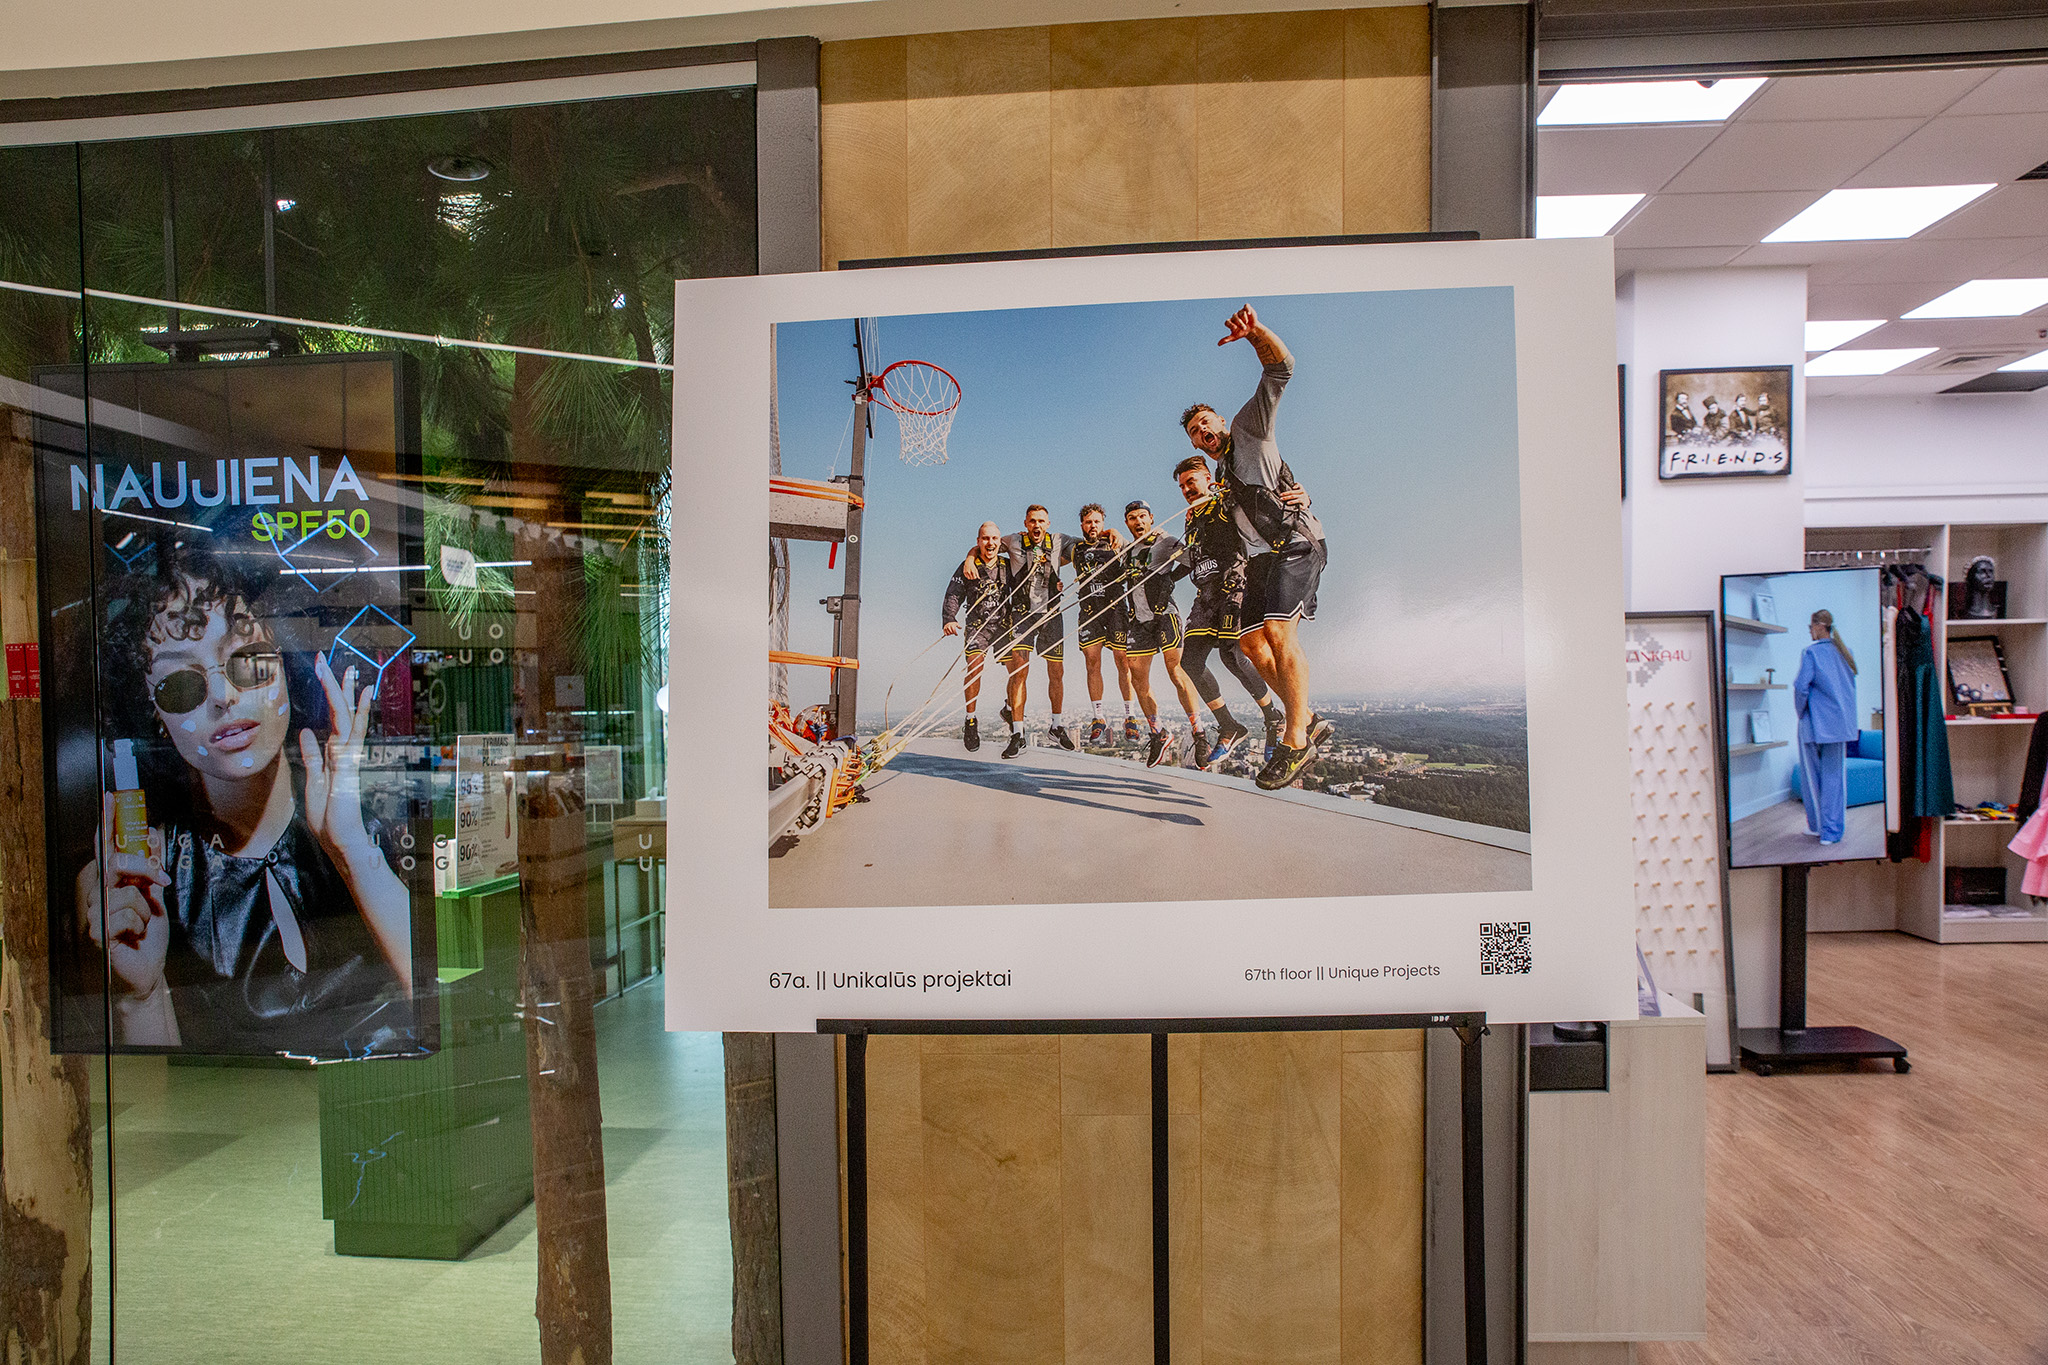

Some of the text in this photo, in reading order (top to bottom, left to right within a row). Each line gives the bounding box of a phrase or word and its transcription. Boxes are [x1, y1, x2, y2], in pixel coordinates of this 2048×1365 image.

[70, 455, 370, 511] NAUJIENA
[251, 508, 371, 542] SPF50
[1114, 630, 1127, 643] 23
[1626, 649, 1693, 663] ANKA4U
[769, 972, 810, 989] 67a.
[833, 971, 917, 989] Unikalūs
[923, 969, 1012, 993] projektai
[1244, 968, 1276, 981] 67th
[1280, 967, 1312, 980] floor
[1328, 966, 1379, 982] Unique
[1383, 964, 1441, 980] Projects
